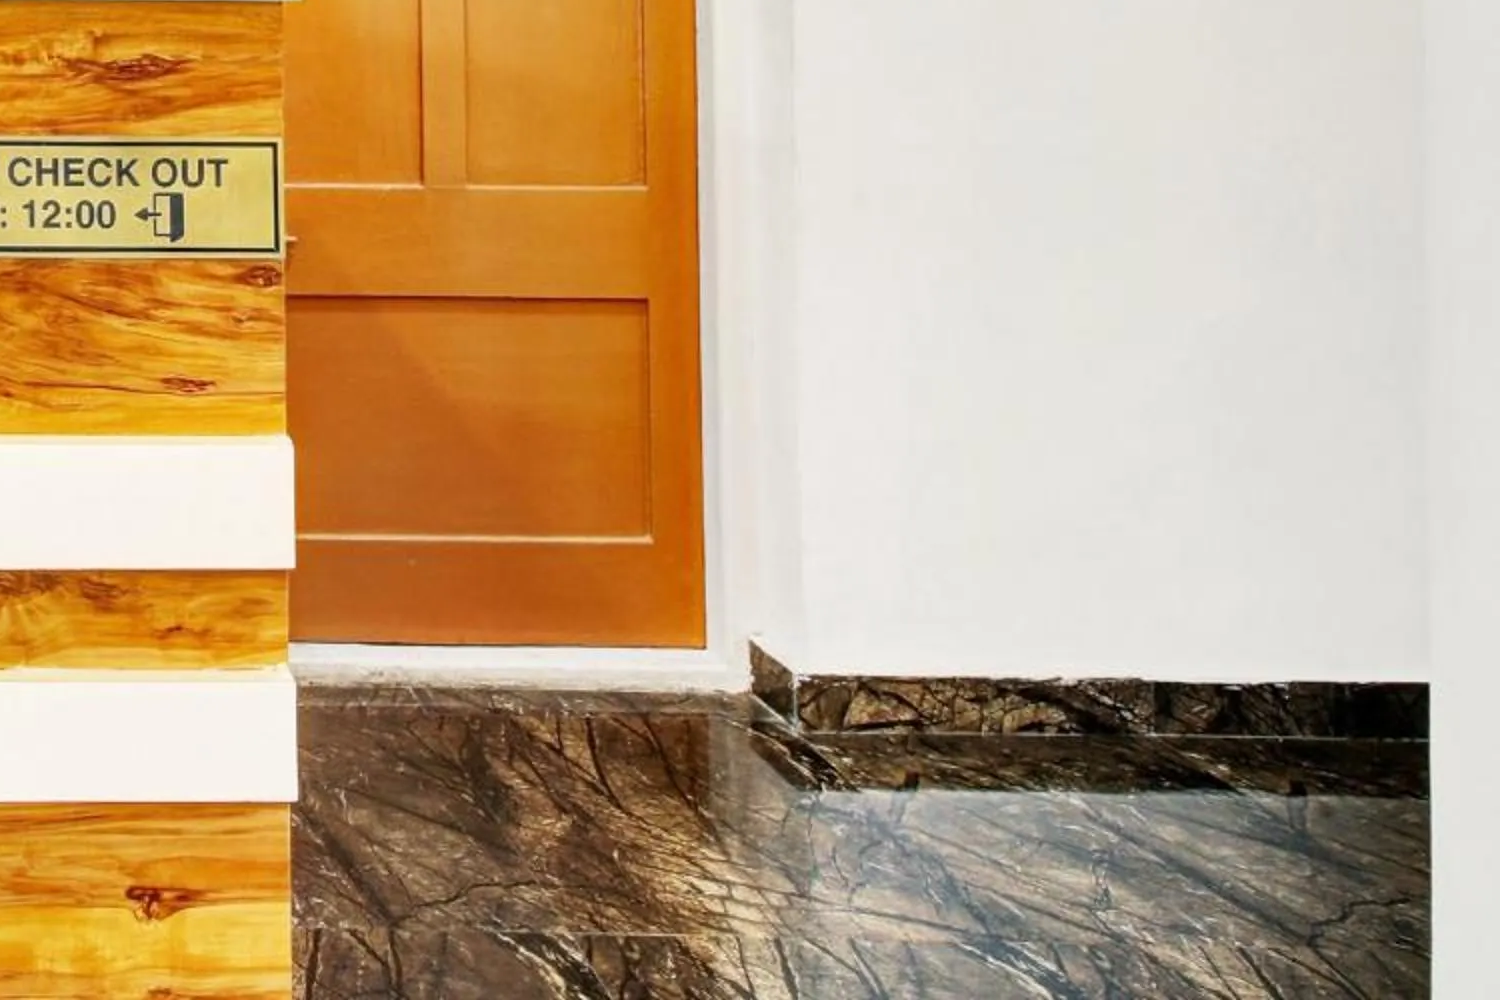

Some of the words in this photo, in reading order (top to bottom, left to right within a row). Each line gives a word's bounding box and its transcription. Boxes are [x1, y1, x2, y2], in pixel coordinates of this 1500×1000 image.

[7, 156, 140, 188] CHECK
[150, 156, 229, 189] OUT
[22, 199, 117, 229] 12:00
